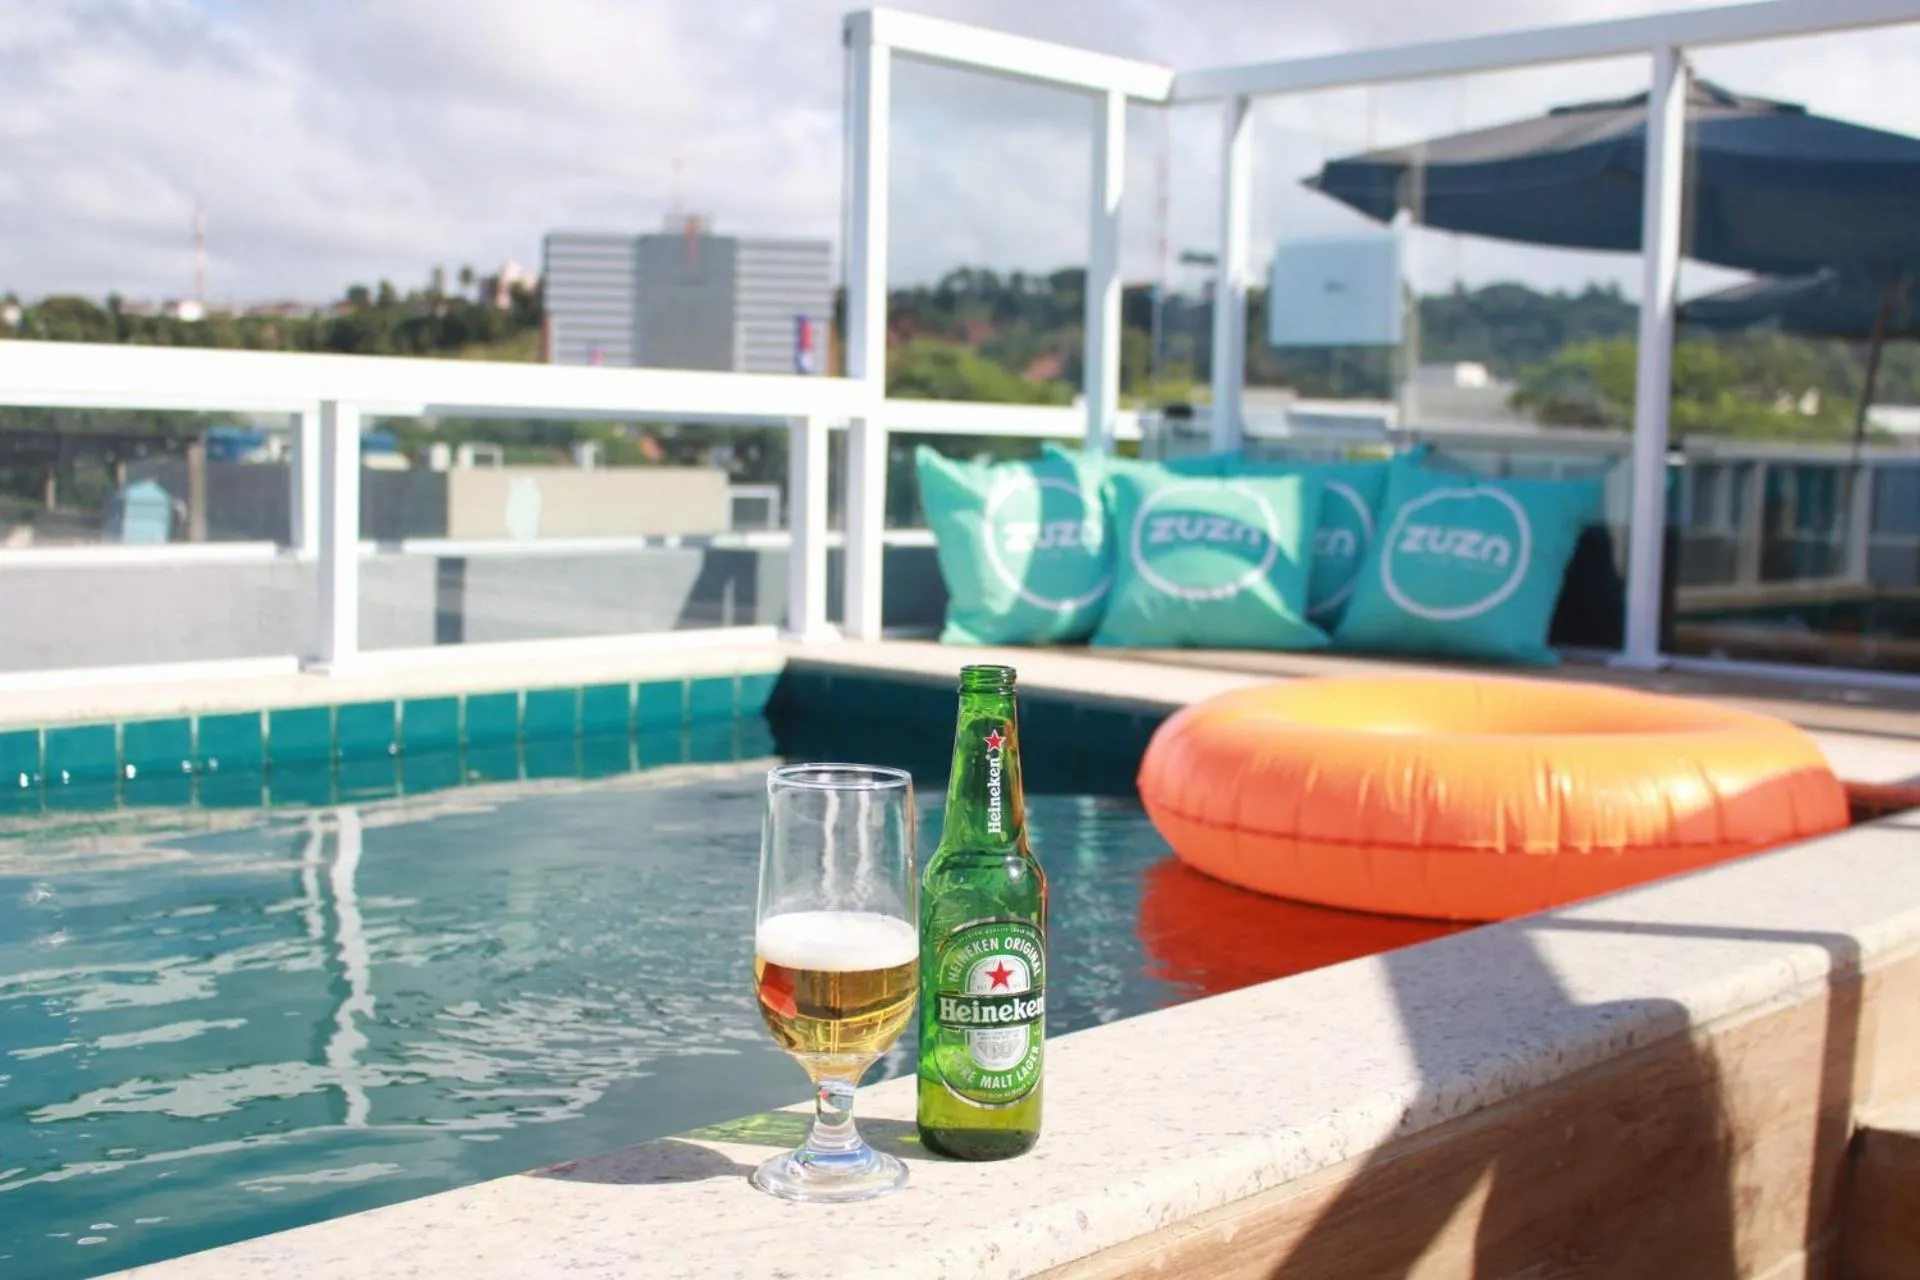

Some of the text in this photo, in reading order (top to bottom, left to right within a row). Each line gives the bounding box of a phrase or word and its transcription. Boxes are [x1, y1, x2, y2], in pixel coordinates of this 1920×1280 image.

[987, 757, 1002, 833] Heineken
[947, 936, 1041, 982] HEINEKEN ORIGINAL
[940, 996, 1044, 1023] Heineken
[980, 1074, 1013, 1089] MALT
[1016, 1045, 1040, 1081] LAGER
